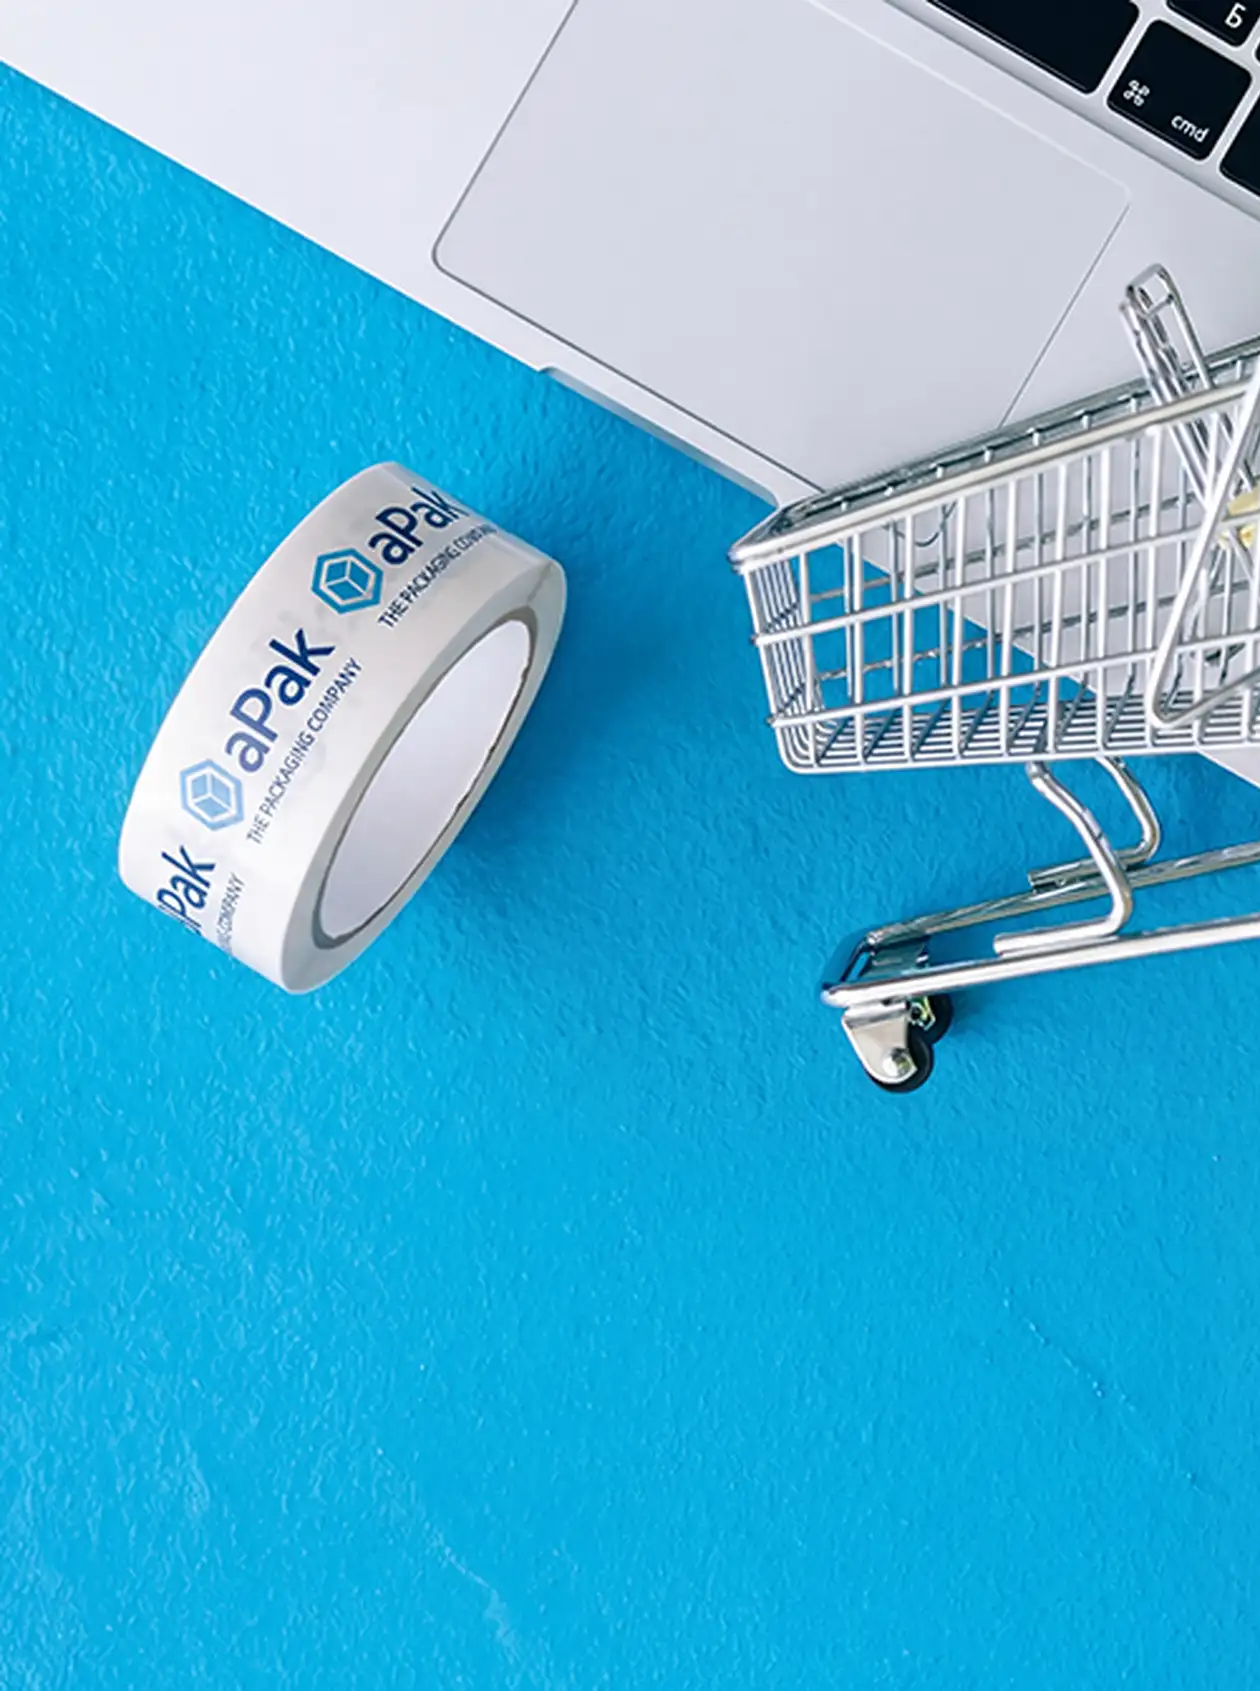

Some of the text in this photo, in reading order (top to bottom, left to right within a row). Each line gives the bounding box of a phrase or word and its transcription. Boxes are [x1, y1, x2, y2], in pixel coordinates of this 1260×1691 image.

[1170, 114, 1211, 144] cmd
[368, 486, 471, 566] aPak
[377, 598, 409, 628] THE
[224, 627, 336, 773] aPak
[246, 656, 363, 845] THE PACKAGING COMPANY
[156, 845, 217, 936] Pak
